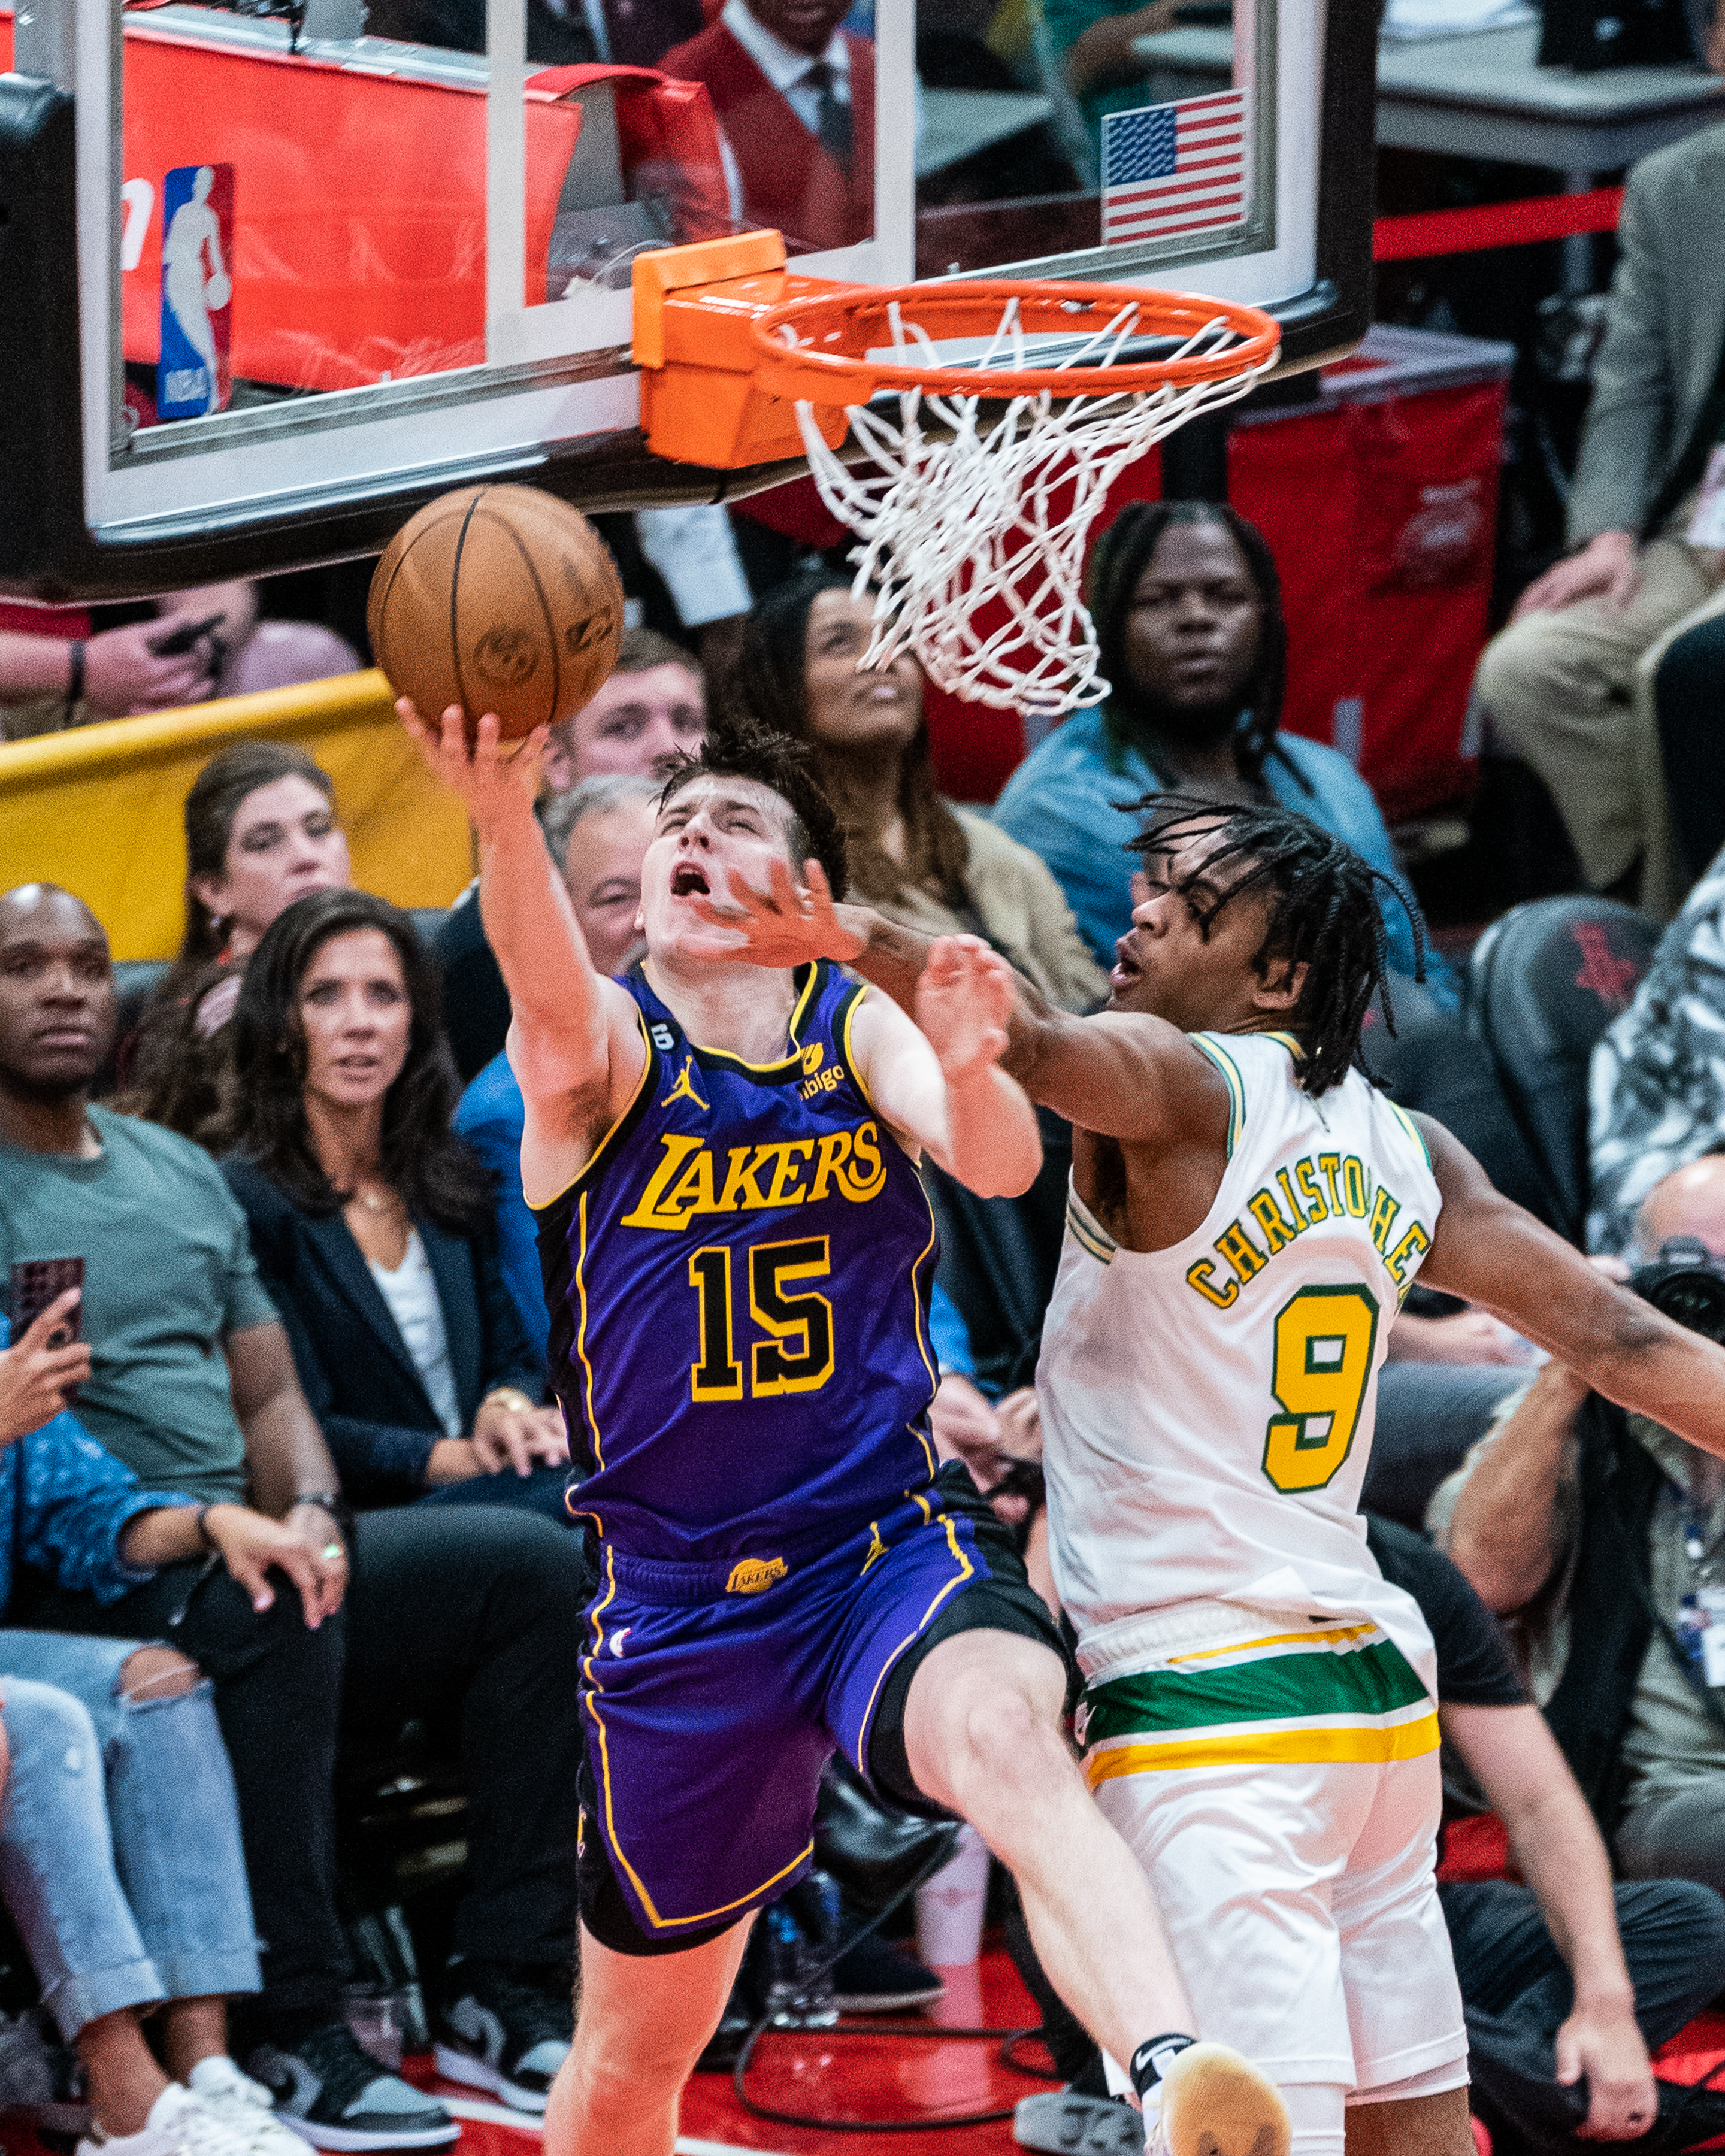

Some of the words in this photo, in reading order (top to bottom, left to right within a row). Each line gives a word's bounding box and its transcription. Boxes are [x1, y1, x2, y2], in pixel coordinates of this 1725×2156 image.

[798, 1065, 845, 1101] ibigo
[620, 1121, 888, 1231] LAKERS
[688, 1234, 835, 1403] 15
[1261, 1282, 1381, 1494] 9
